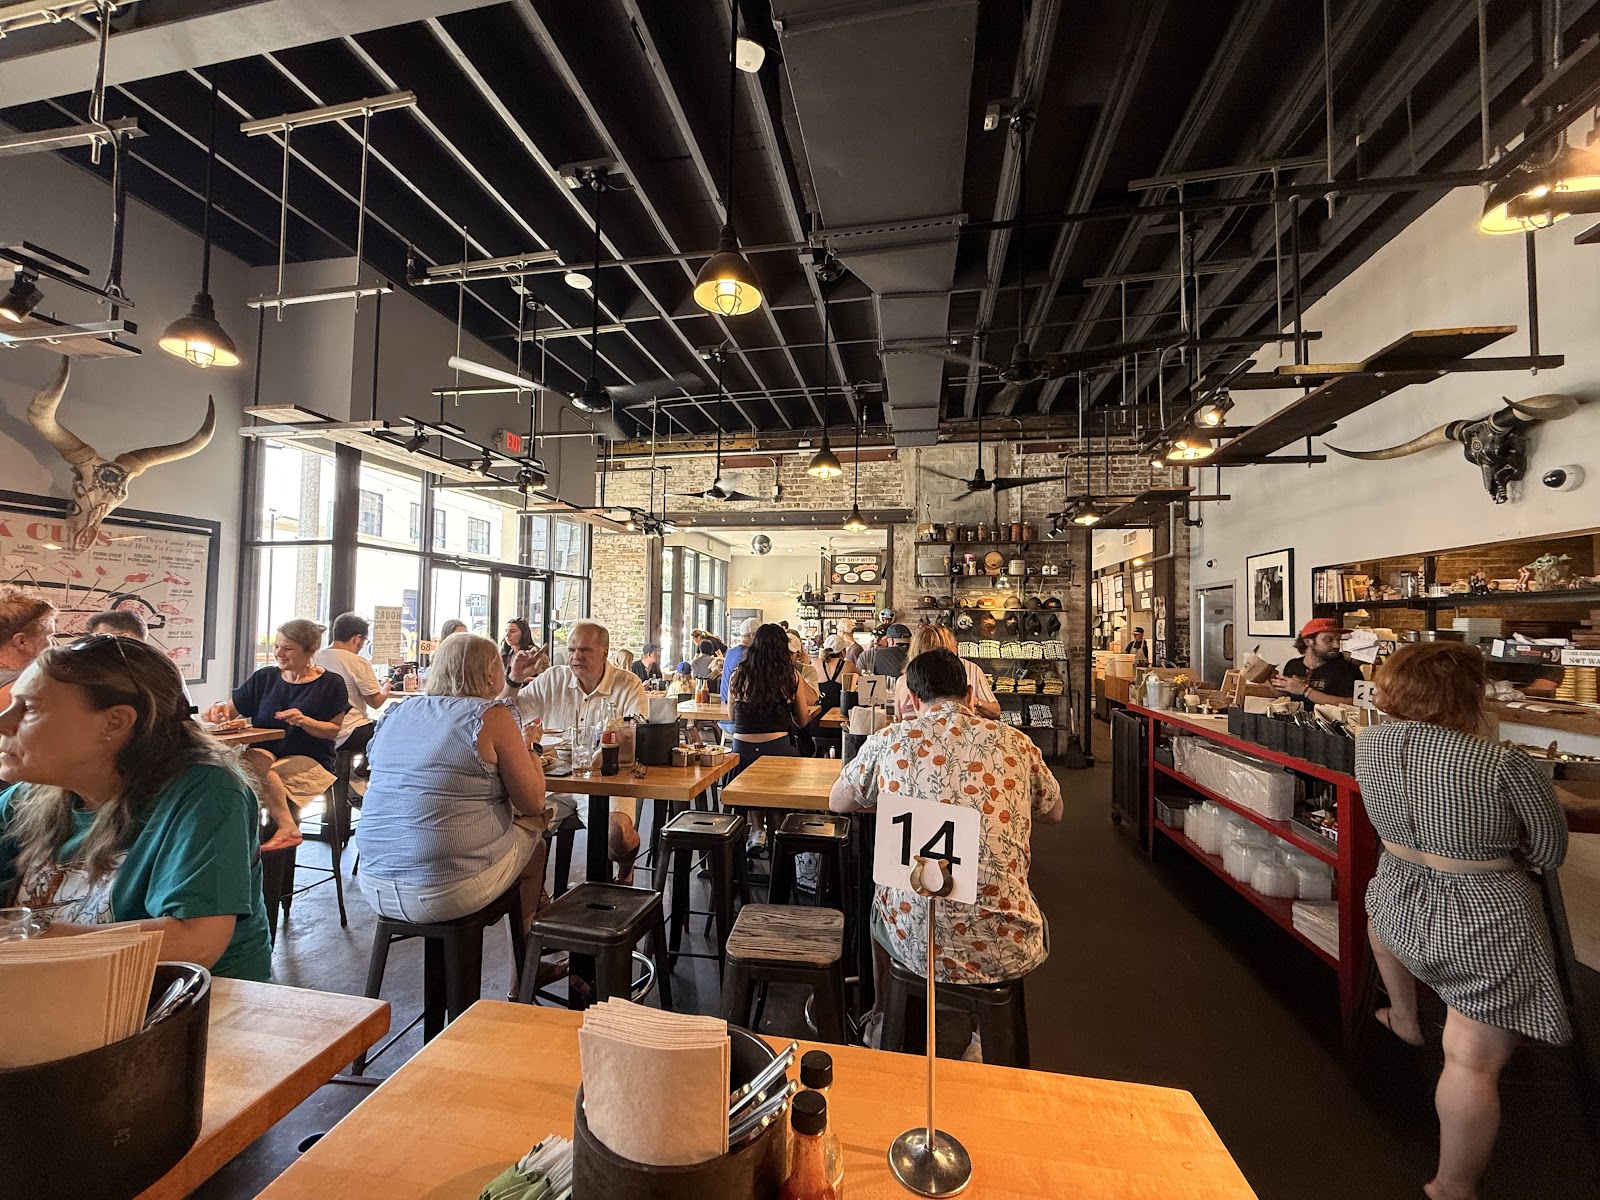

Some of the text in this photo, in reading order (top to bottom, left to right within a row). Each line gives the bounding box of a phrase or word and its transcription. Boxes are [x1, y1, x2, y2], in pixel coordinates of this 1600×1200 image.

[506, 431, 522, 453] EXIT
[26, 522, 113, 547] CUS
[134, 542, 152, 550] How
[420, 643, 431, 651] 68
[867, 680, 877, 697] 7
[892, 812, 961, 876] 14
